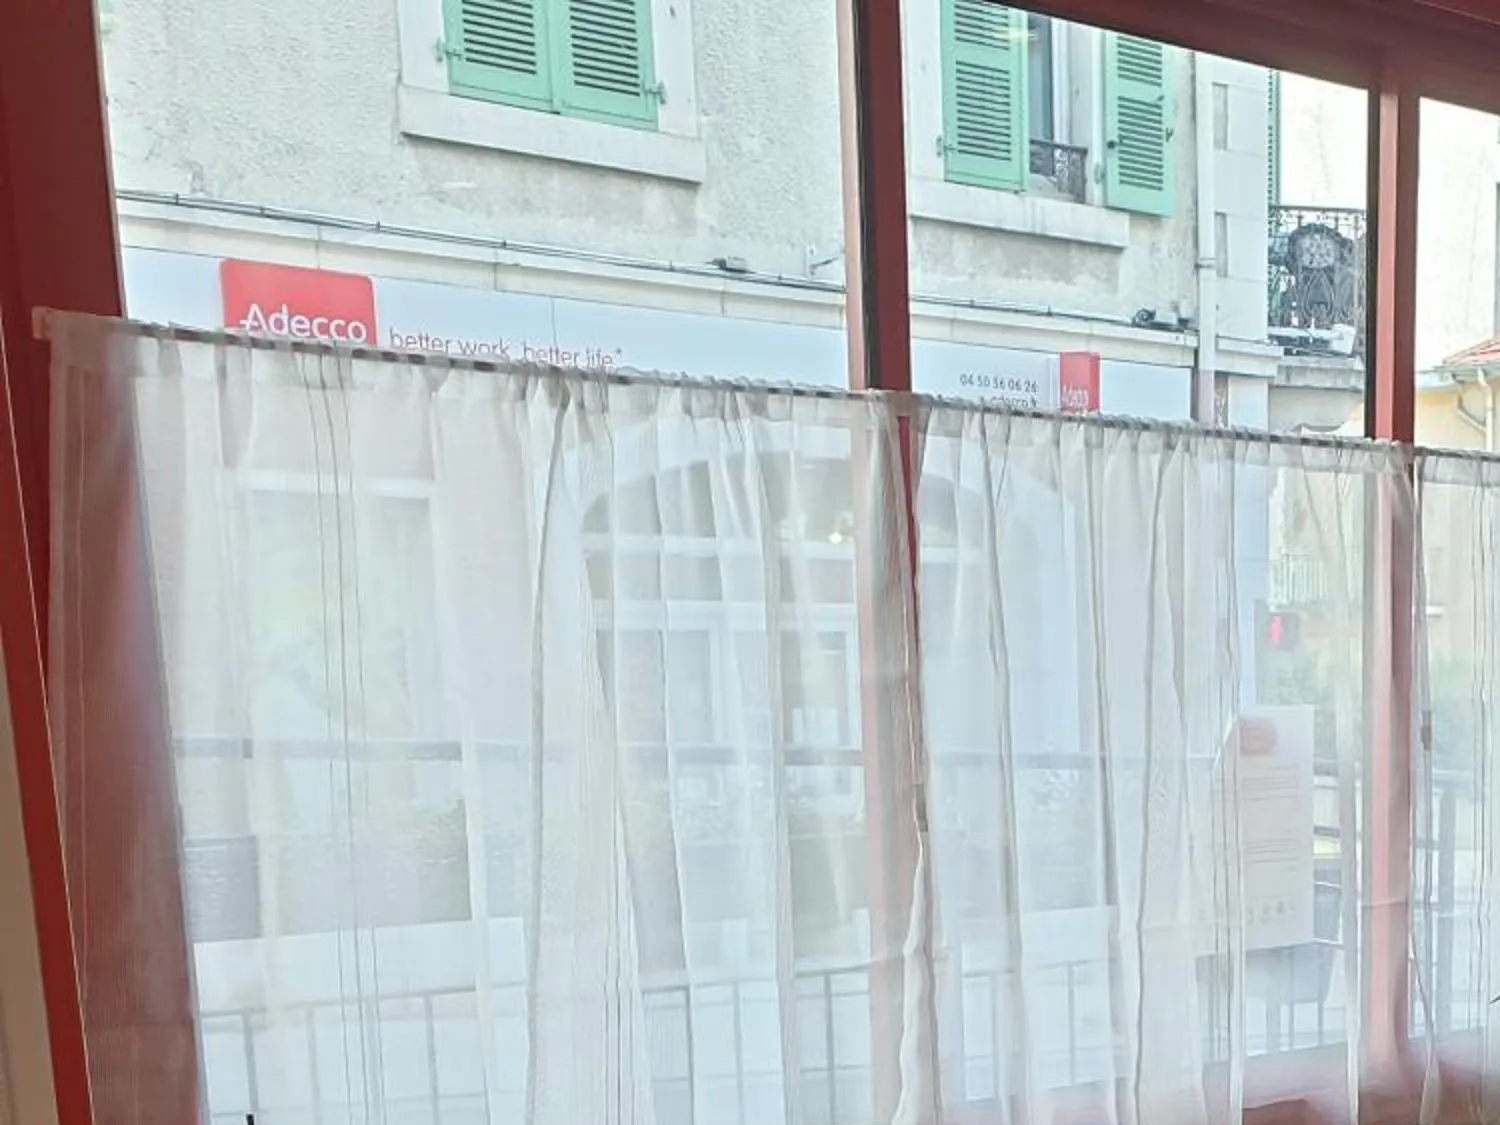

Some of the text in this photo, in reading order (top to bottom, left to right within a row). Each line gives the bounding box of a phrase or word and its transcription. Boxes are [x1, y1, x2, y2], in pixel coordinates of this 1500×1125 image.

[241, 303, 367, 343] Adecco
[389, 326, 450, 353] better
[523, 341, 578, 368] better
